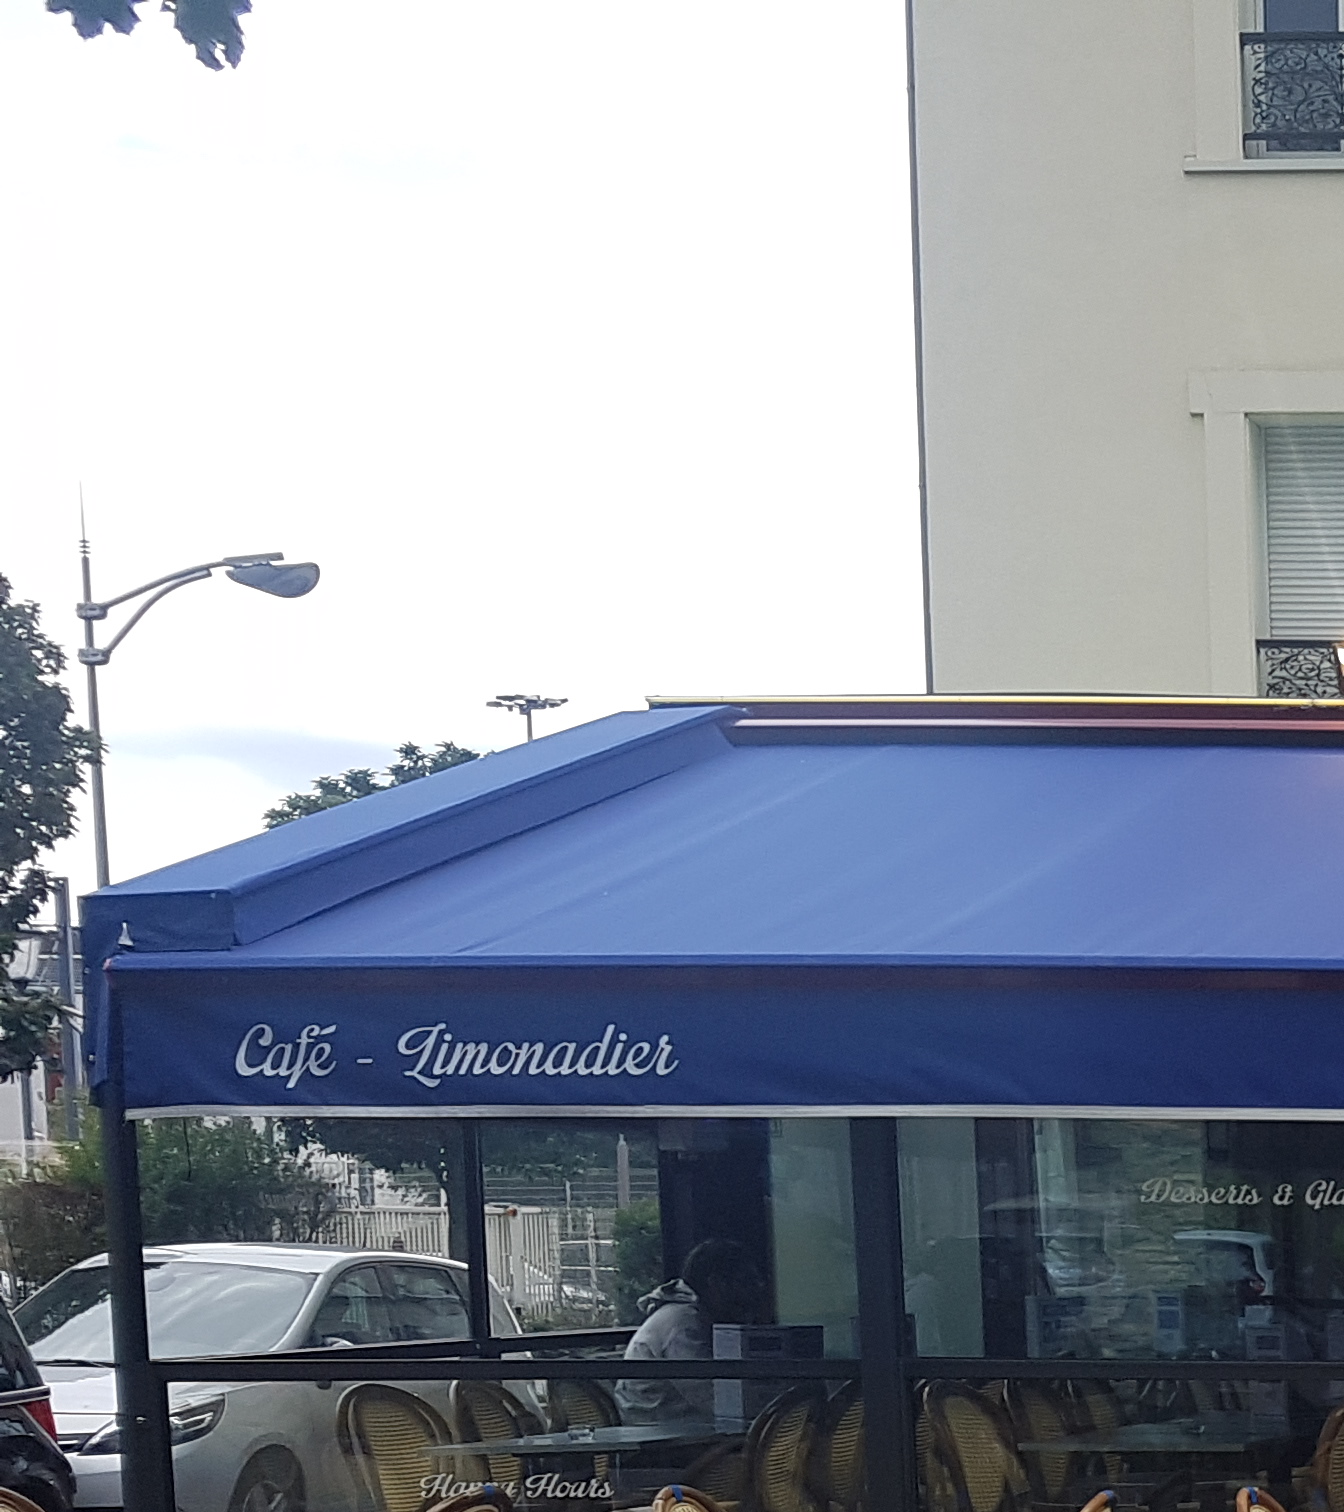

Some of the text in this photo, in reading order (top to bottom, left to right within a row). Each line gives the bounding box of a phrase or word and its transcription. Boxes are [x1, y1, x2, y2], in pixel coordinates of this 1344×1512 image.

[235, 1023, 338, 1089] Café
[396, 1022, 680, 1088] Limonadier
[1140, 1177, 1263, 1205] Desserts
[1272, 1183, 1294, 1206] &
[525, 1473, 615, 1498] Hours
